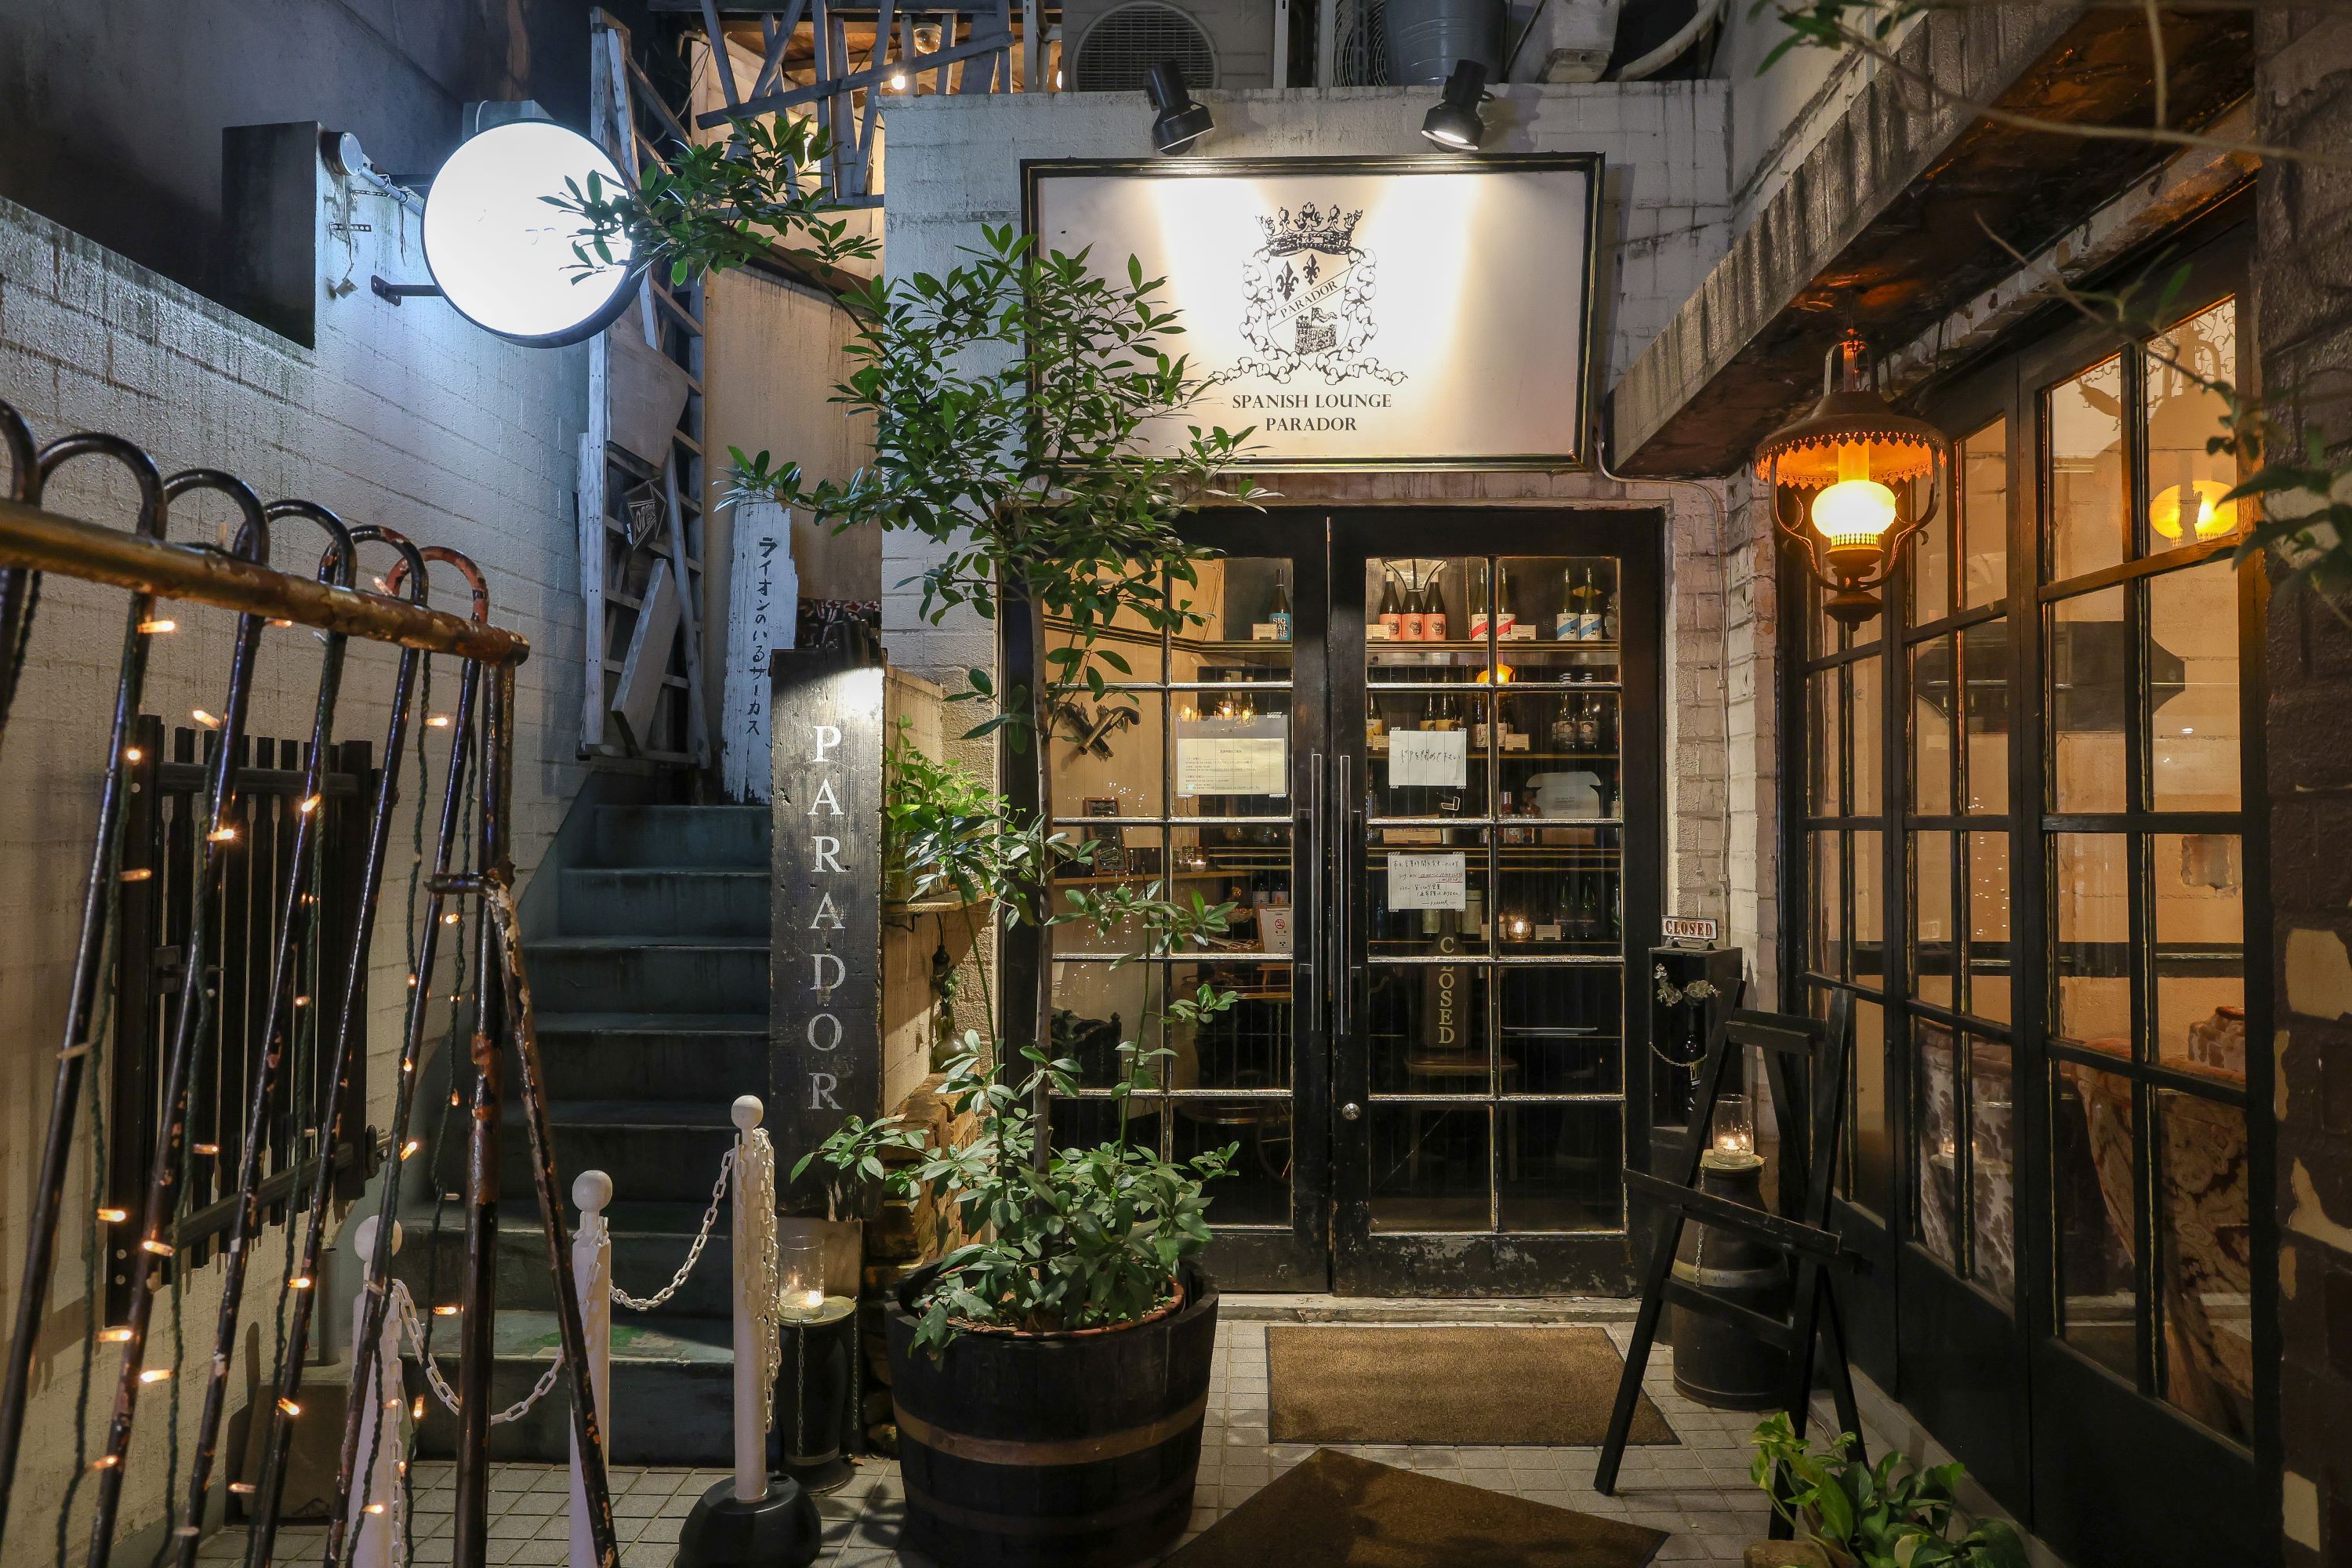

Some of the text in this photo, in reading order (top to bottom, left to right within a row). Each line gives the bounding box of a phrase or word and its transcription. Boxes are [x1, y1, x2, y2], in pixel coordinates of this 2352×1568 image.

[1280, 281, 1338, 318] PARADOR
[1232, 394, 1392, 408] SPANISH LOUNGE
[1265, 417, 1358, 431] PARADOR
[746, 536, 779, 735] ライオンのいるサーカス
[807, 724, 849, 1110] PARADOR
[1665, 920, 1713, 937] CLOSED
